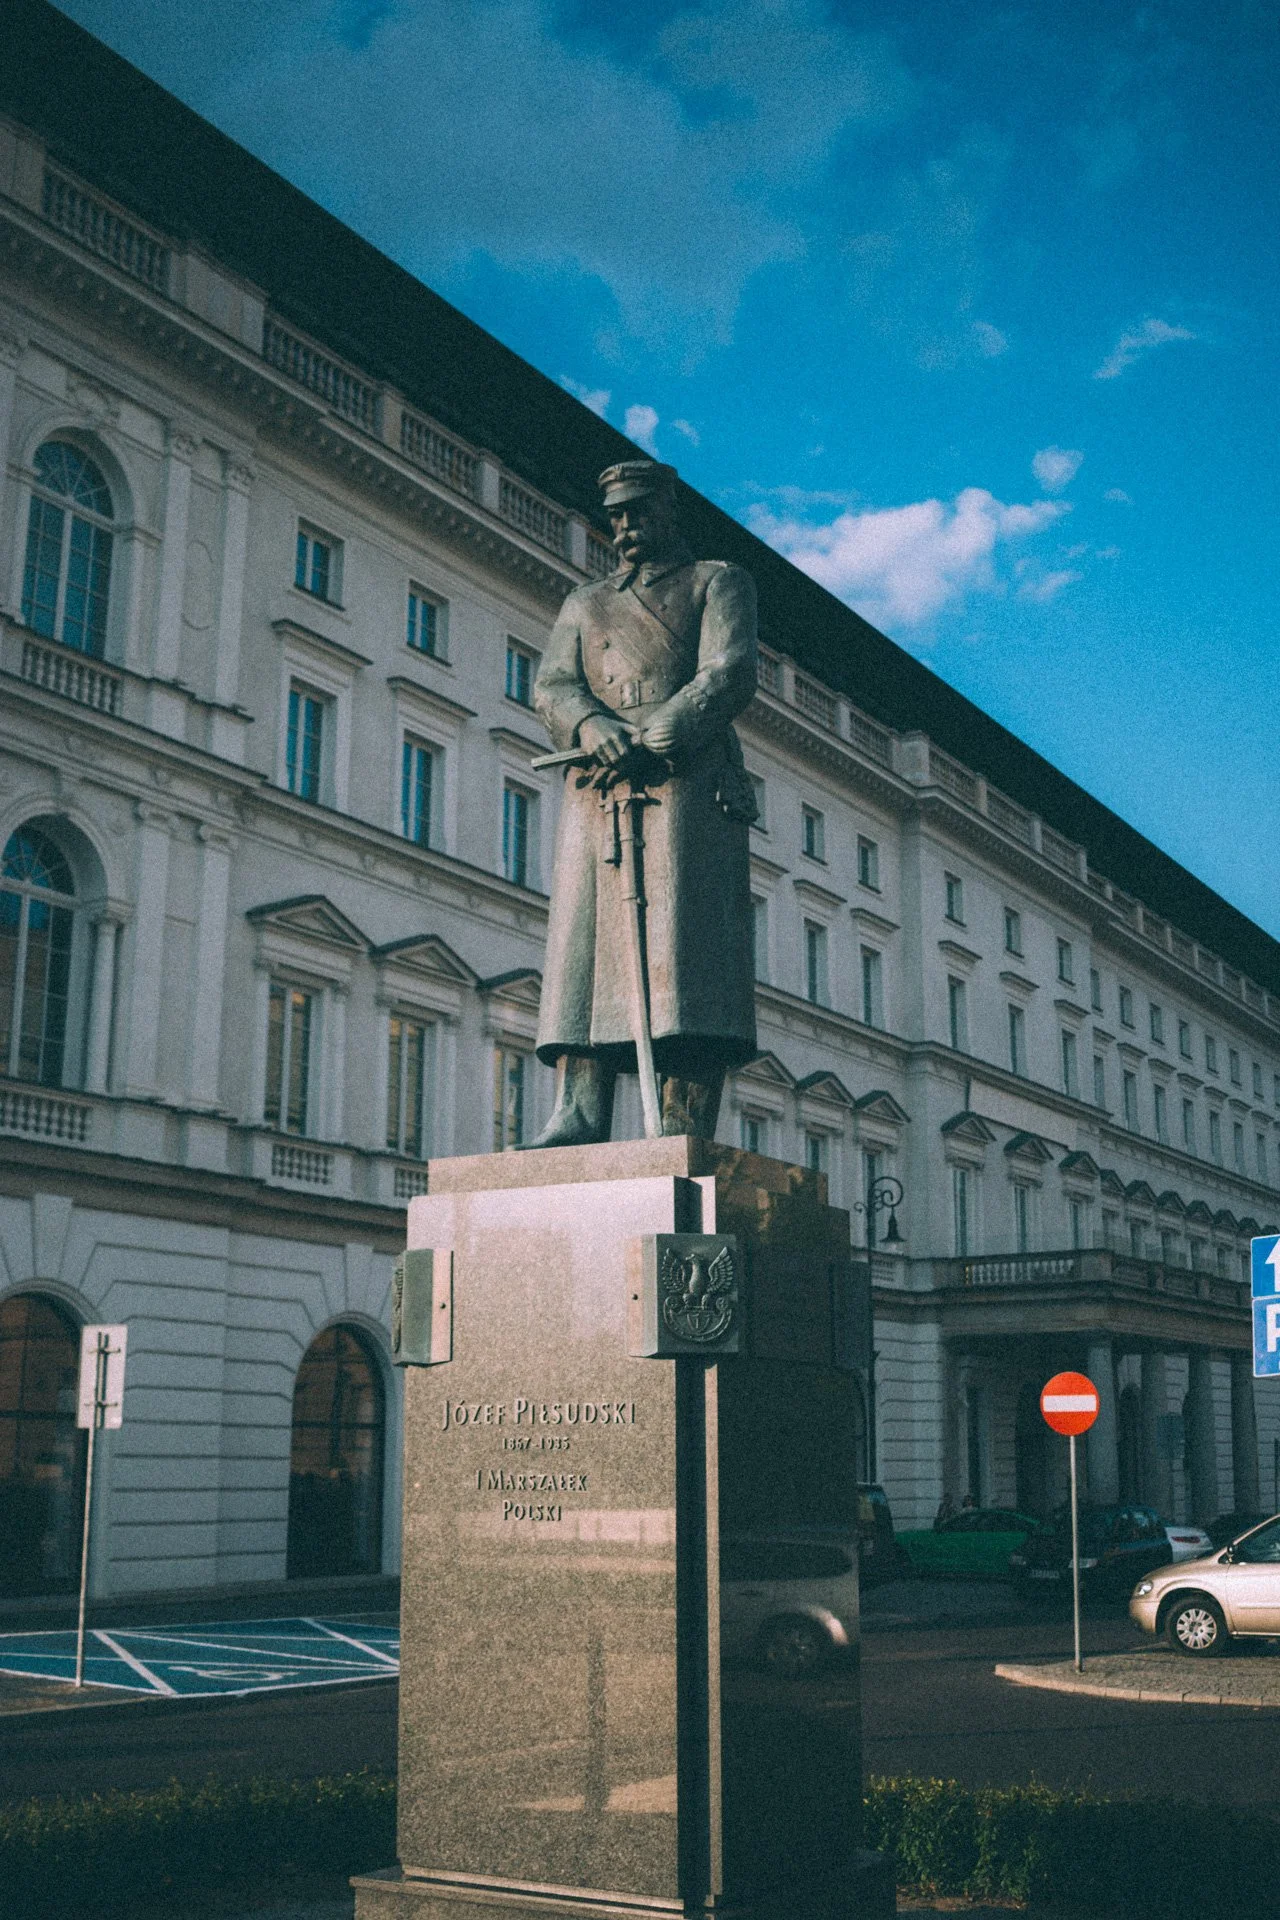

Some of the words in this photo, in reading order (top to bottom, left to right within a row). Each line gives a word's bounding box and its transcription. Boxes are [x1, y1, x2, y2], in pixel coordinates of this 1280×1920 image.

[442, 1399, 507, 1431] JÓZEF
[514, 1398, 636, 1425] PIŁSUDSKI
[475, 1469, 482, 1490] I
[487, 1469, 588, 1491] MARSZAŁEK
[502, 1500, 562, 1521] POLSKI
